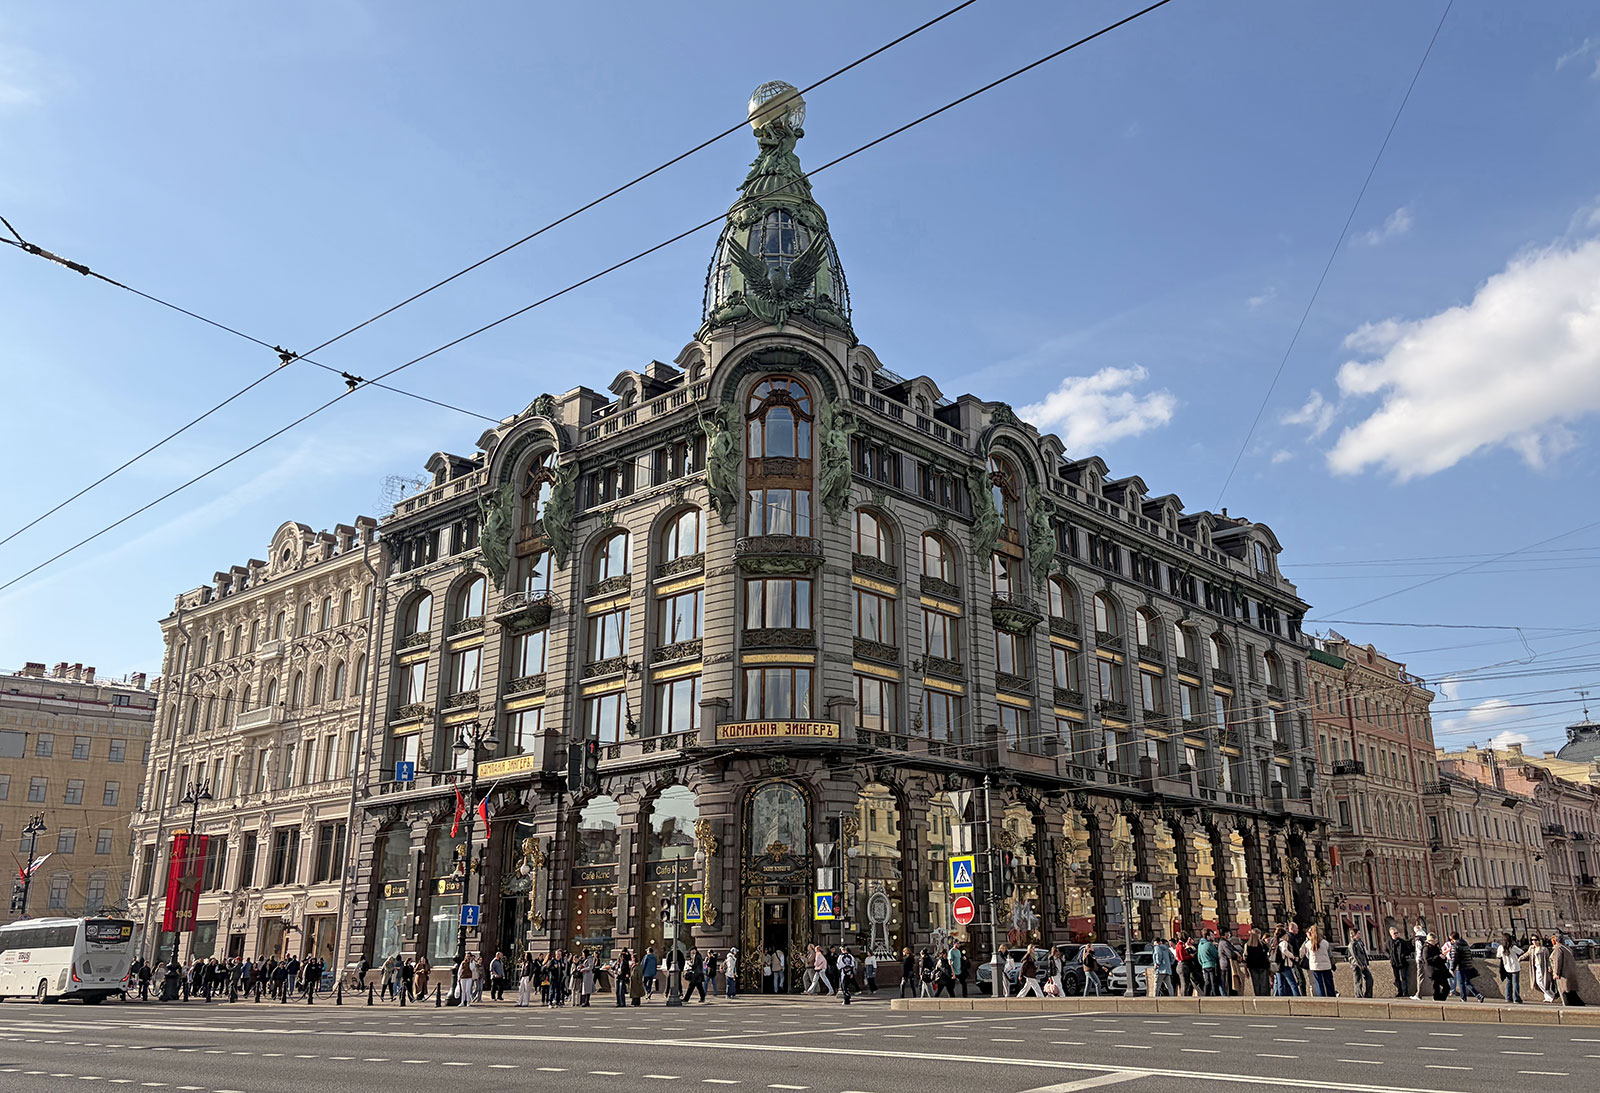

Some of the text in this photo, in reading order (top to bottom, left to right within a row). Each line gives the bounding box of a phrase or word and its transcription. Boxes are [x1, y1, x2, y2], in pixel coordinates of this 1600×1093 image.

[722, 723, 833, 737] КОМПАНІЯ ЗИНГЕРЪ
[1134, 885, 1151, 897] СТОП
[175, 909, 193, 918] 1945
